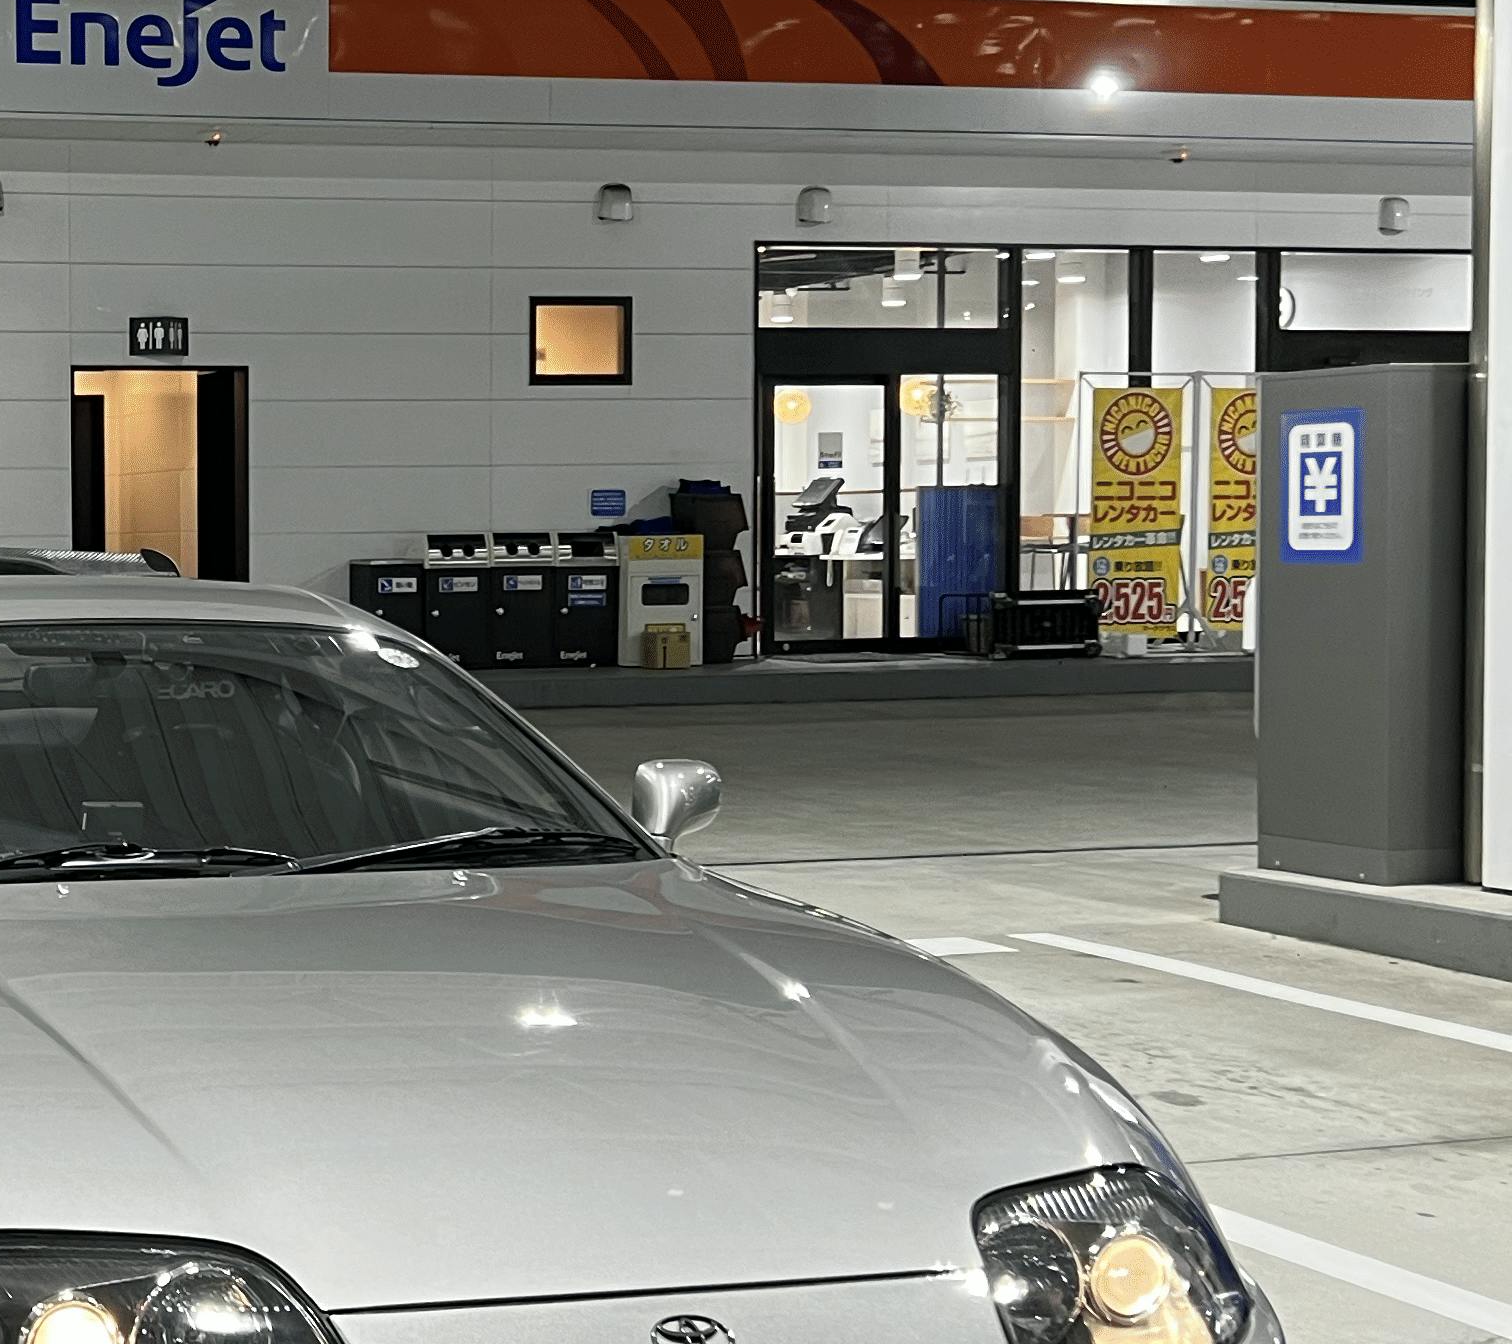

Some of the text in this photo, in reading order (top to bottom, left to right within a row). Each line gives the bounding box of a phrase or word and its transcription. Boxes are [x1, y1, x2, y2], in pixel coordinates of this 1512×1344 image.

[1094, 480, 1177, 501] ニコニコ
[1093, 503, 1177, 523] レンタカー
[643, 538, 688, 552] タオル
